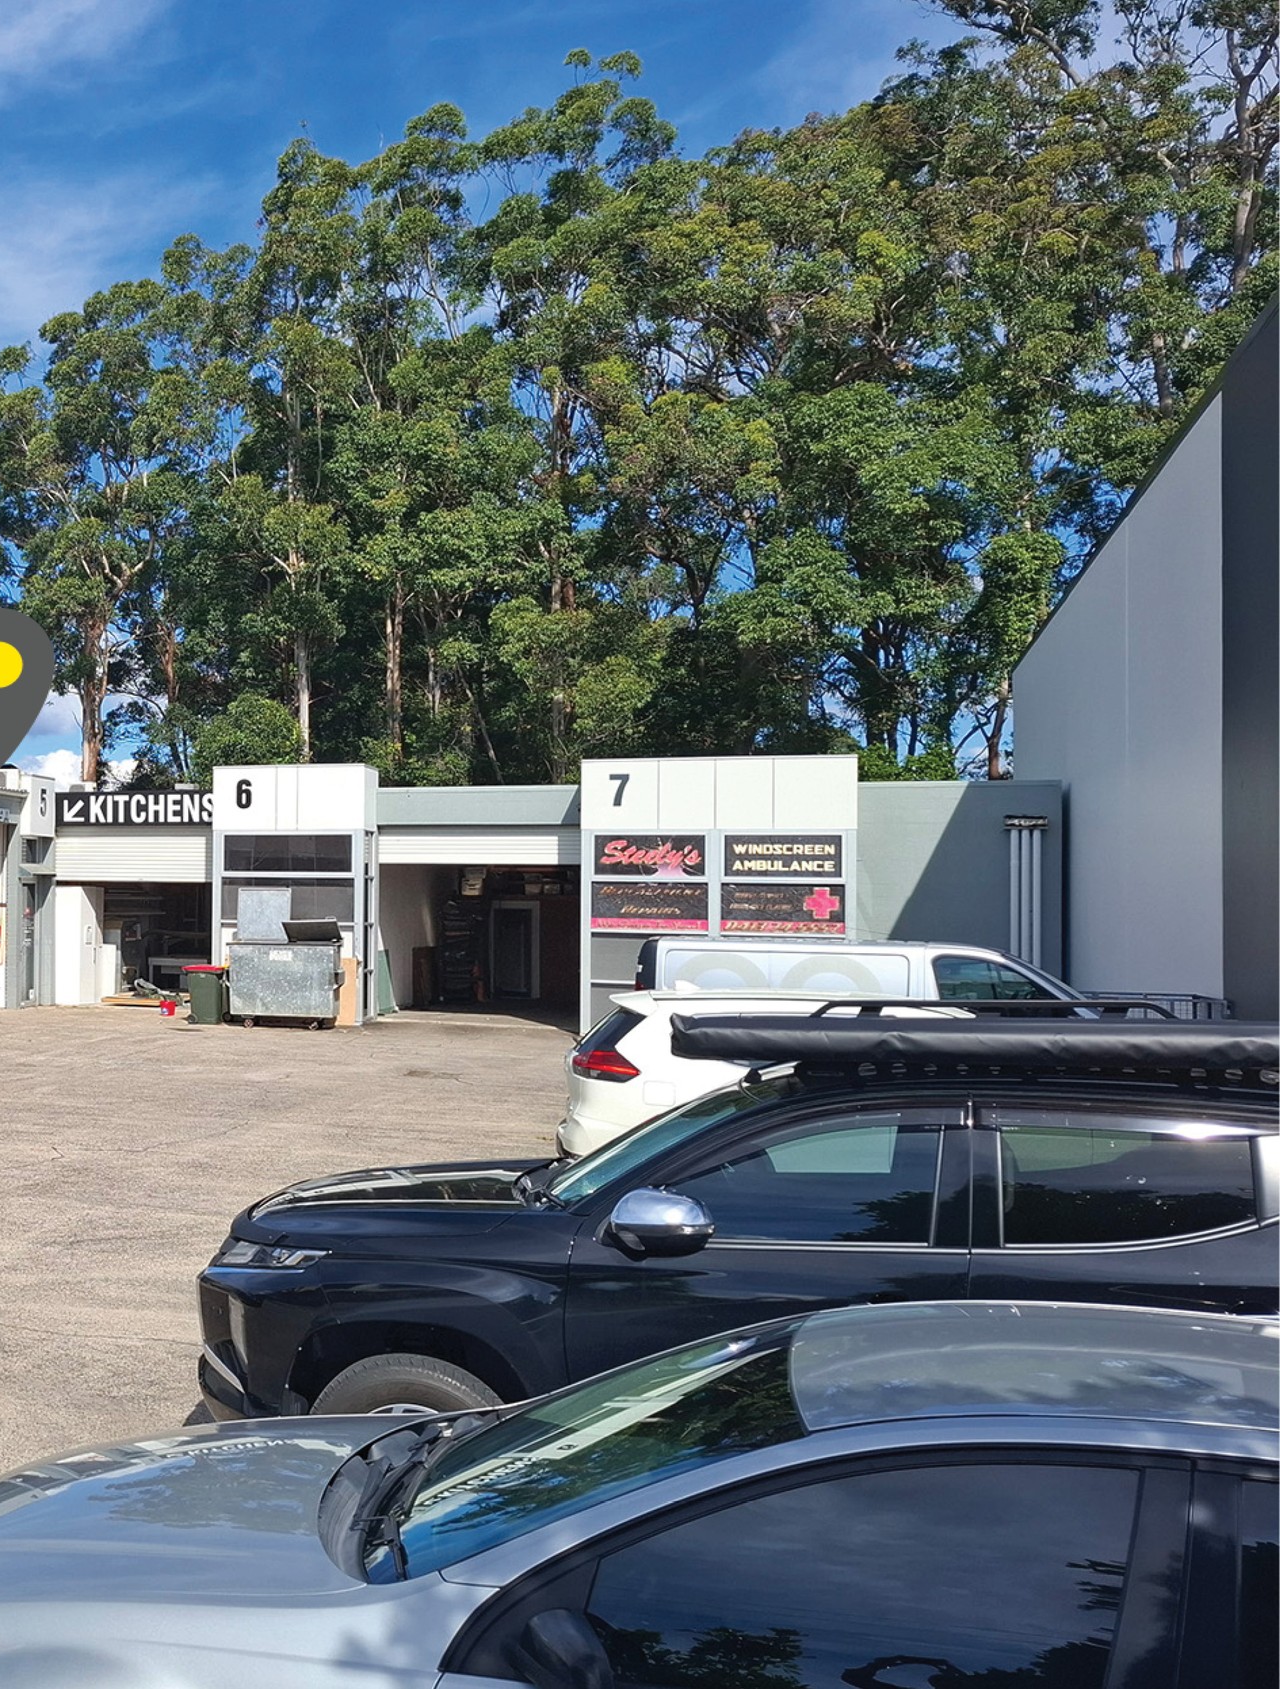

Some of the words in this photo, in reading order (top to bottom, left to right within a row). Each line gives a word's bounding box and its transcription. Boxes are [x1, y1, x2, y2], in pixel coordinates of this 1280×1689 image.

[40, 788, 47, 817] 5
[236, 779, 252, 809] 6
[609, 774, 630, 807] 7
[89, 794, 213, 823] KITCHENS
[601, 840, 702, 870] Steely's
[732, 844, 836, 855] WINDSCREEN
[732, 861, 836, 872] AMBULANCE
